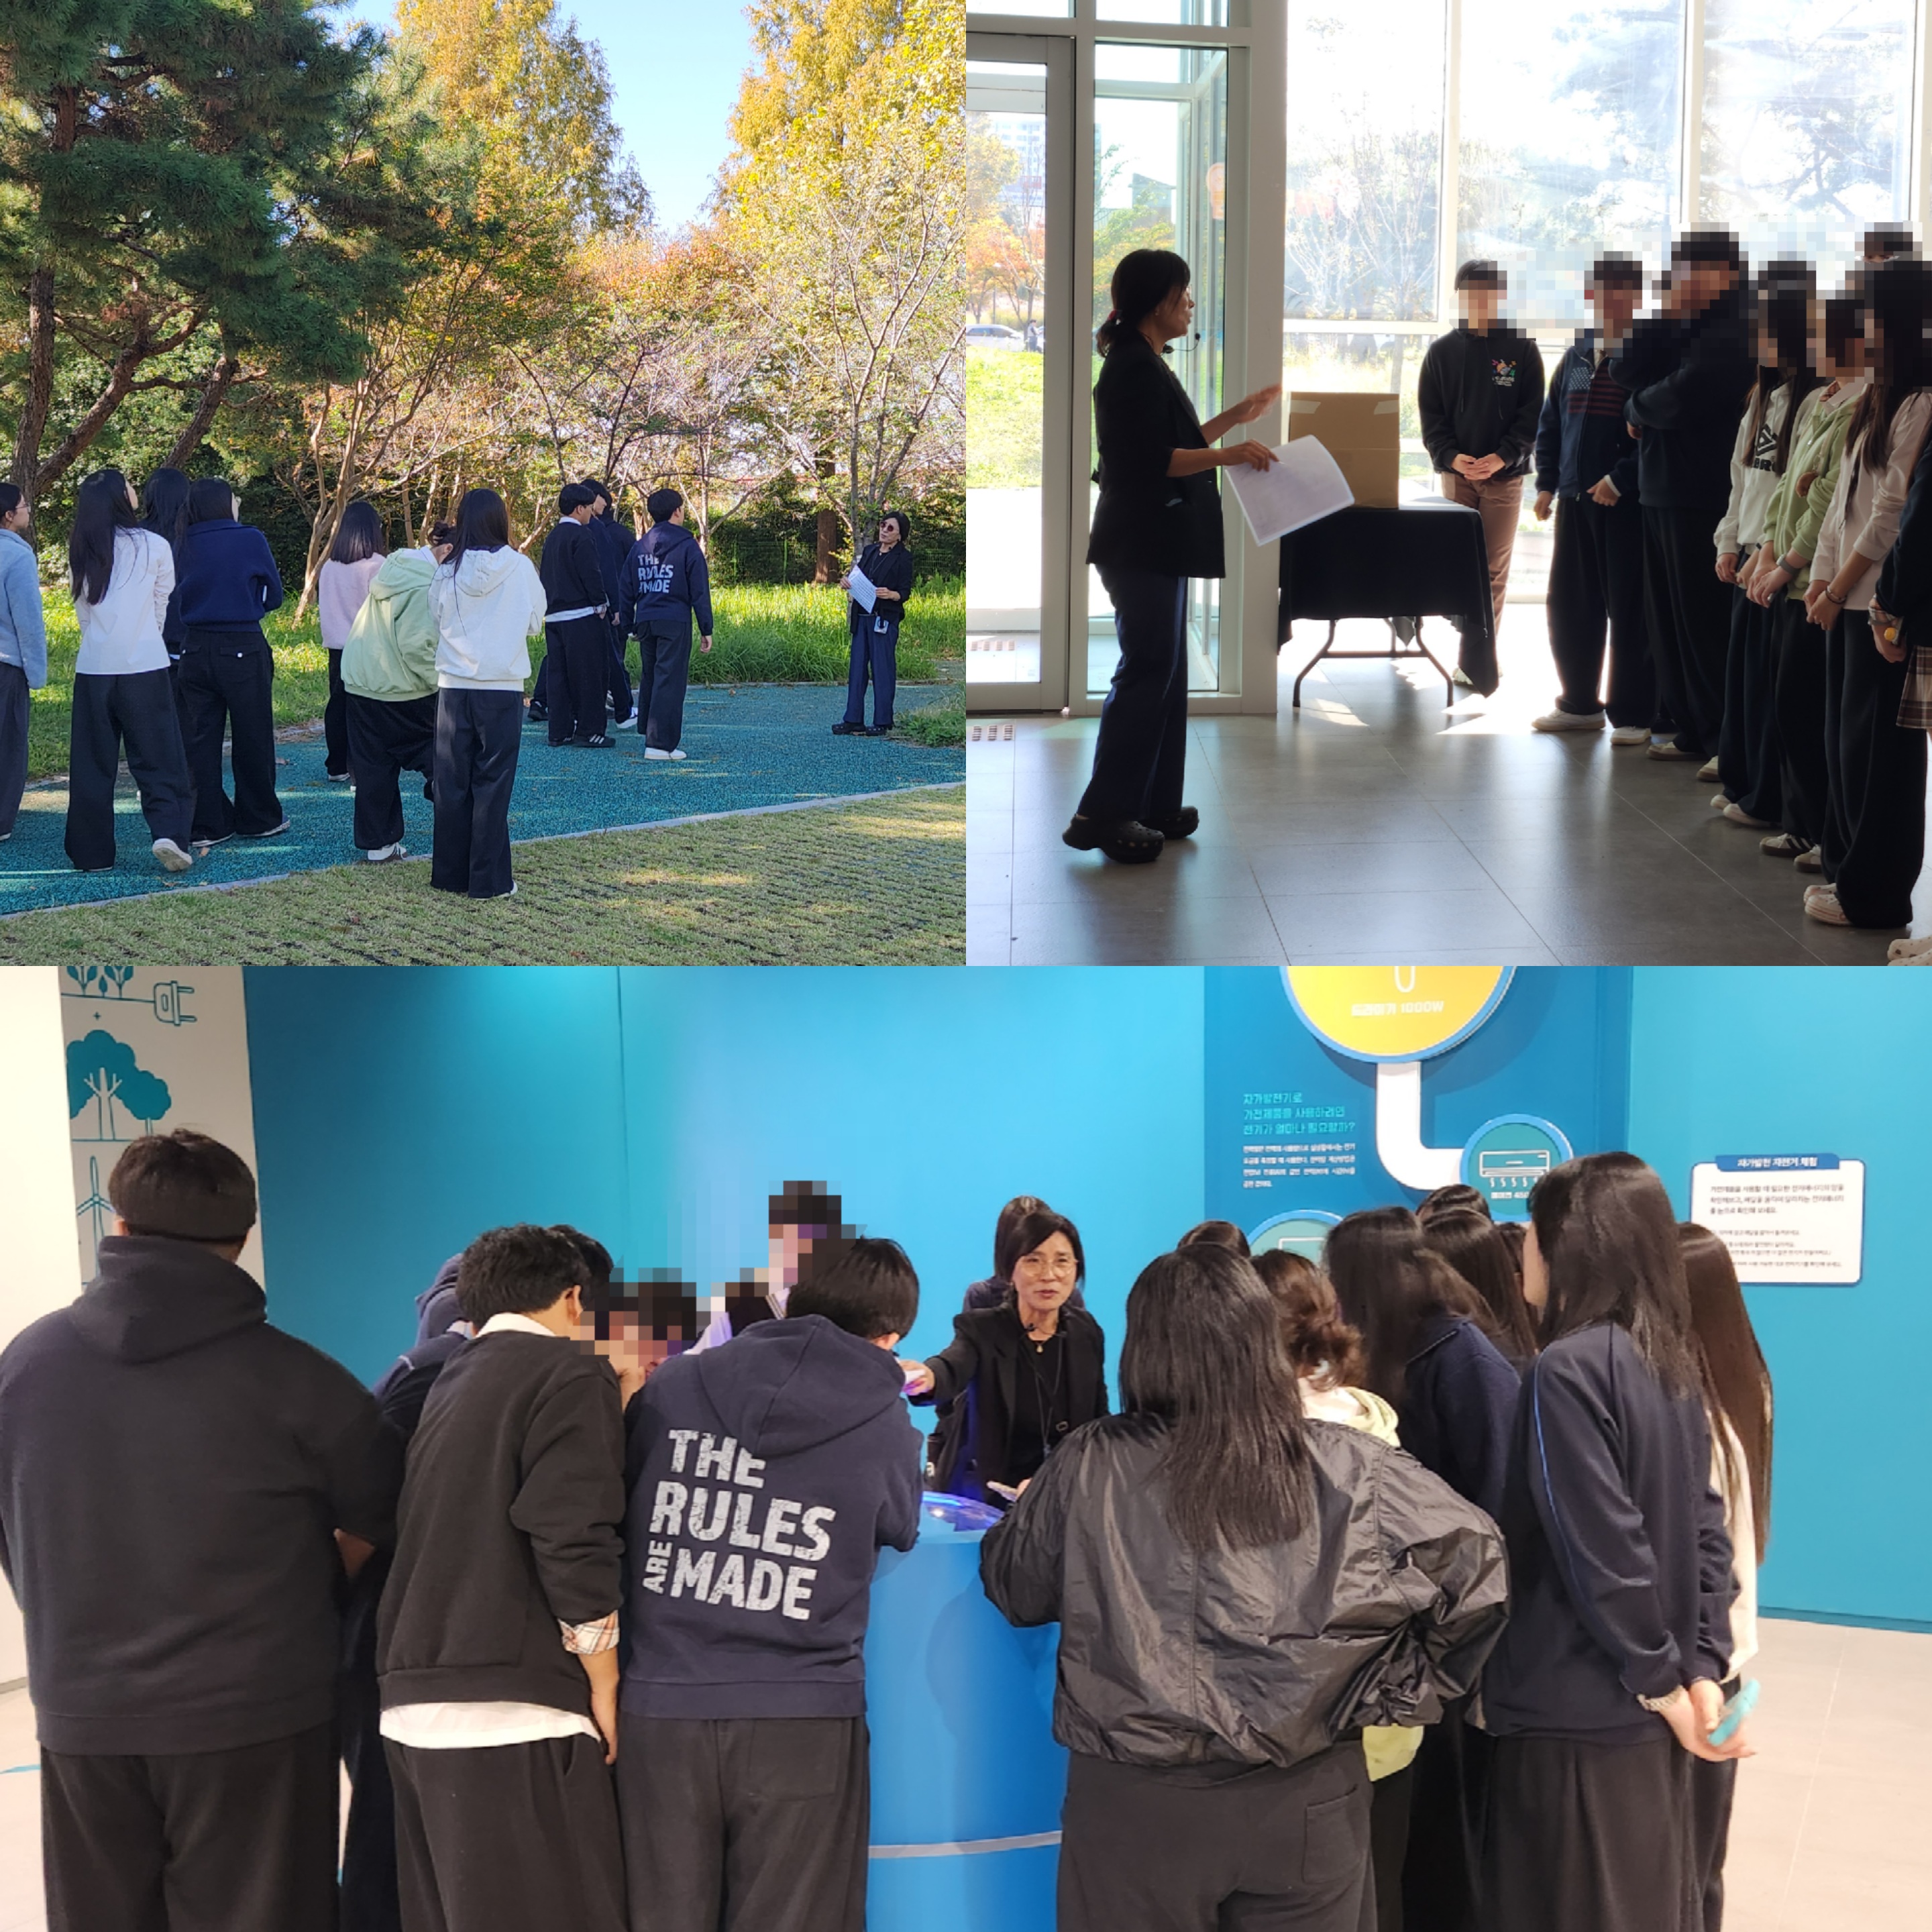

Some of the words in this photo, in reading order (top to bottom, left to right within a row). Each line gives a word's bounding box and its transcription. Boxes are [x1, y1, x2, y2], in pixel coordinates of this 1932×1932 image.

[638, 554, 659, 566] THE
[638, 564, 674, 581] RULES
[1400, 1000, 1444, 1014] 1000W
[1276, 1122, 1305, 1134] 얼마나
[668, 1429, 766, 1489] THE
[649, 1480, 837, 1562] RULES
[642, 1540, 673, 1594] ARE
[669, 1548, 818, 1620] MADE
